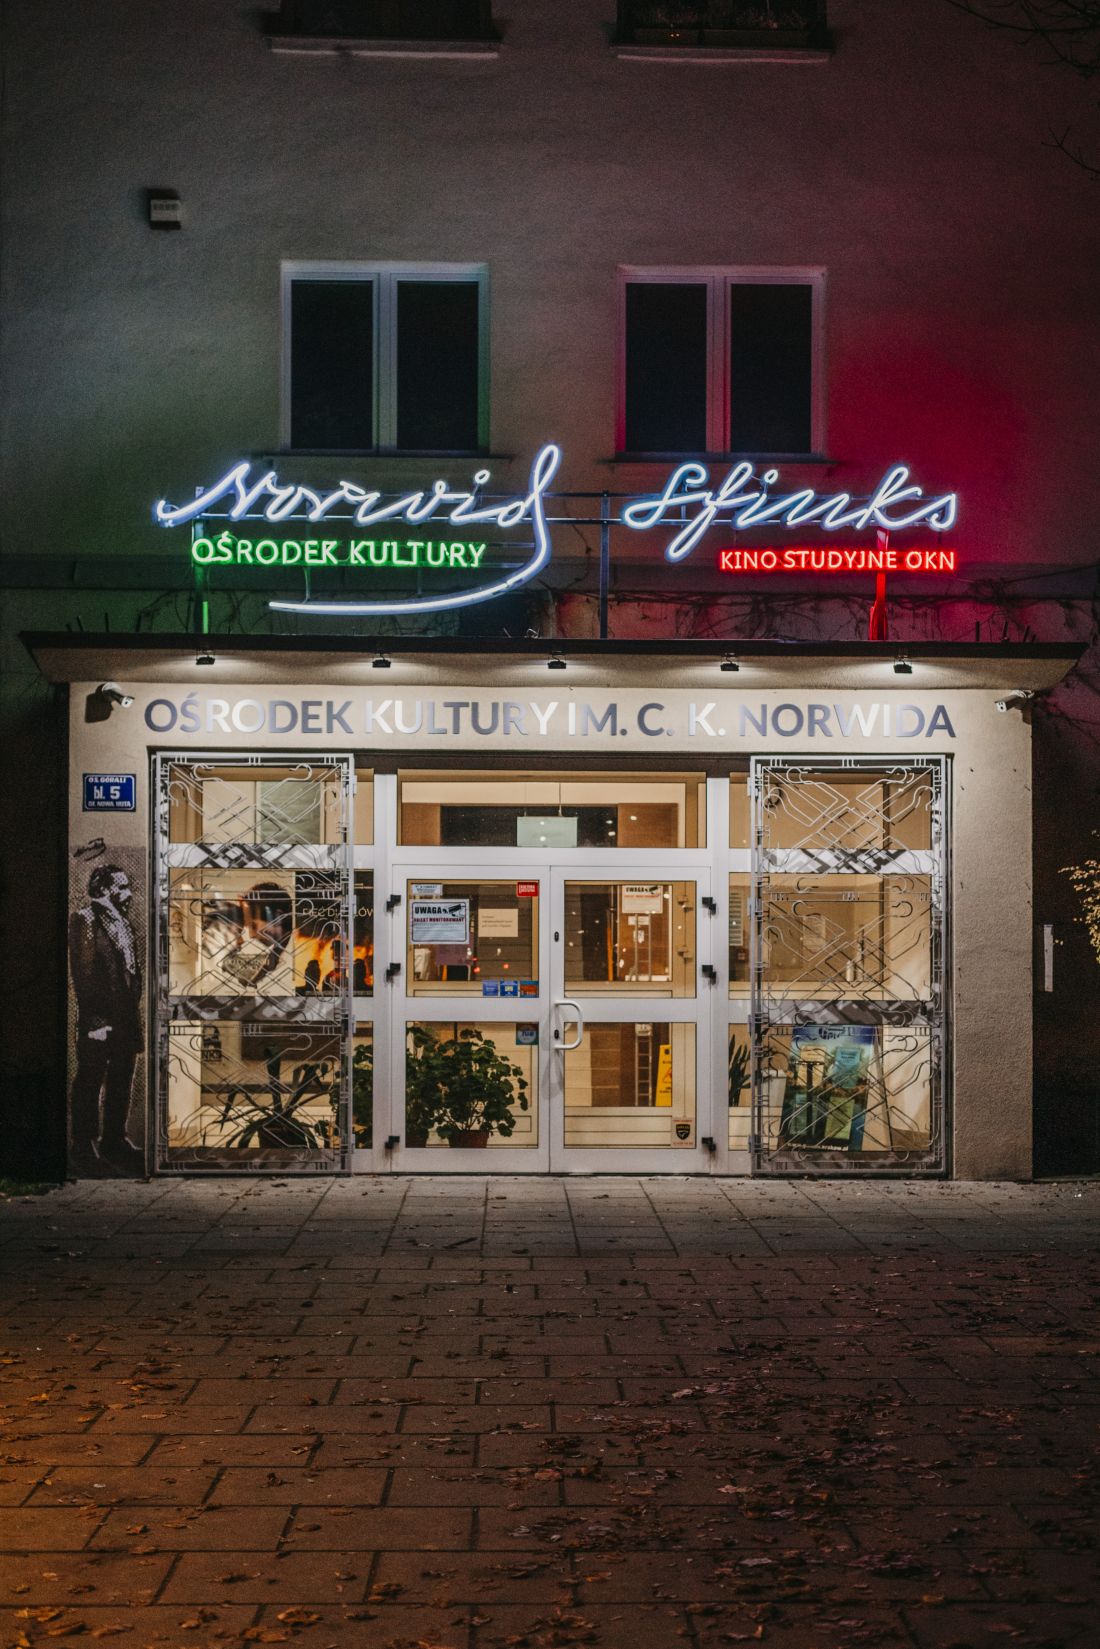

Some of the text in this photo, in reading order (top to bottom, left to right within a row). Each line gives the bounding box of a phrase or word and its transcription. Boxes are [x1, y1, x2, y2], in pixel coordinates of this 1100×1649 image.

[154, 443, 562, 613] Norwid
[622, 461, 958, 562] Sfinks
[191, 531, 487, 568] OŚRODEK KULTURY
[720, 550, 955, 571] KINO STUDYJNE OKN
[144, 692, 957, 738] OŚRODEK KULTURY IM. C. K. NORWIDA
[93, 785, 121, 800] bl. 5
[414, 906, 442, 914] UWAGA
